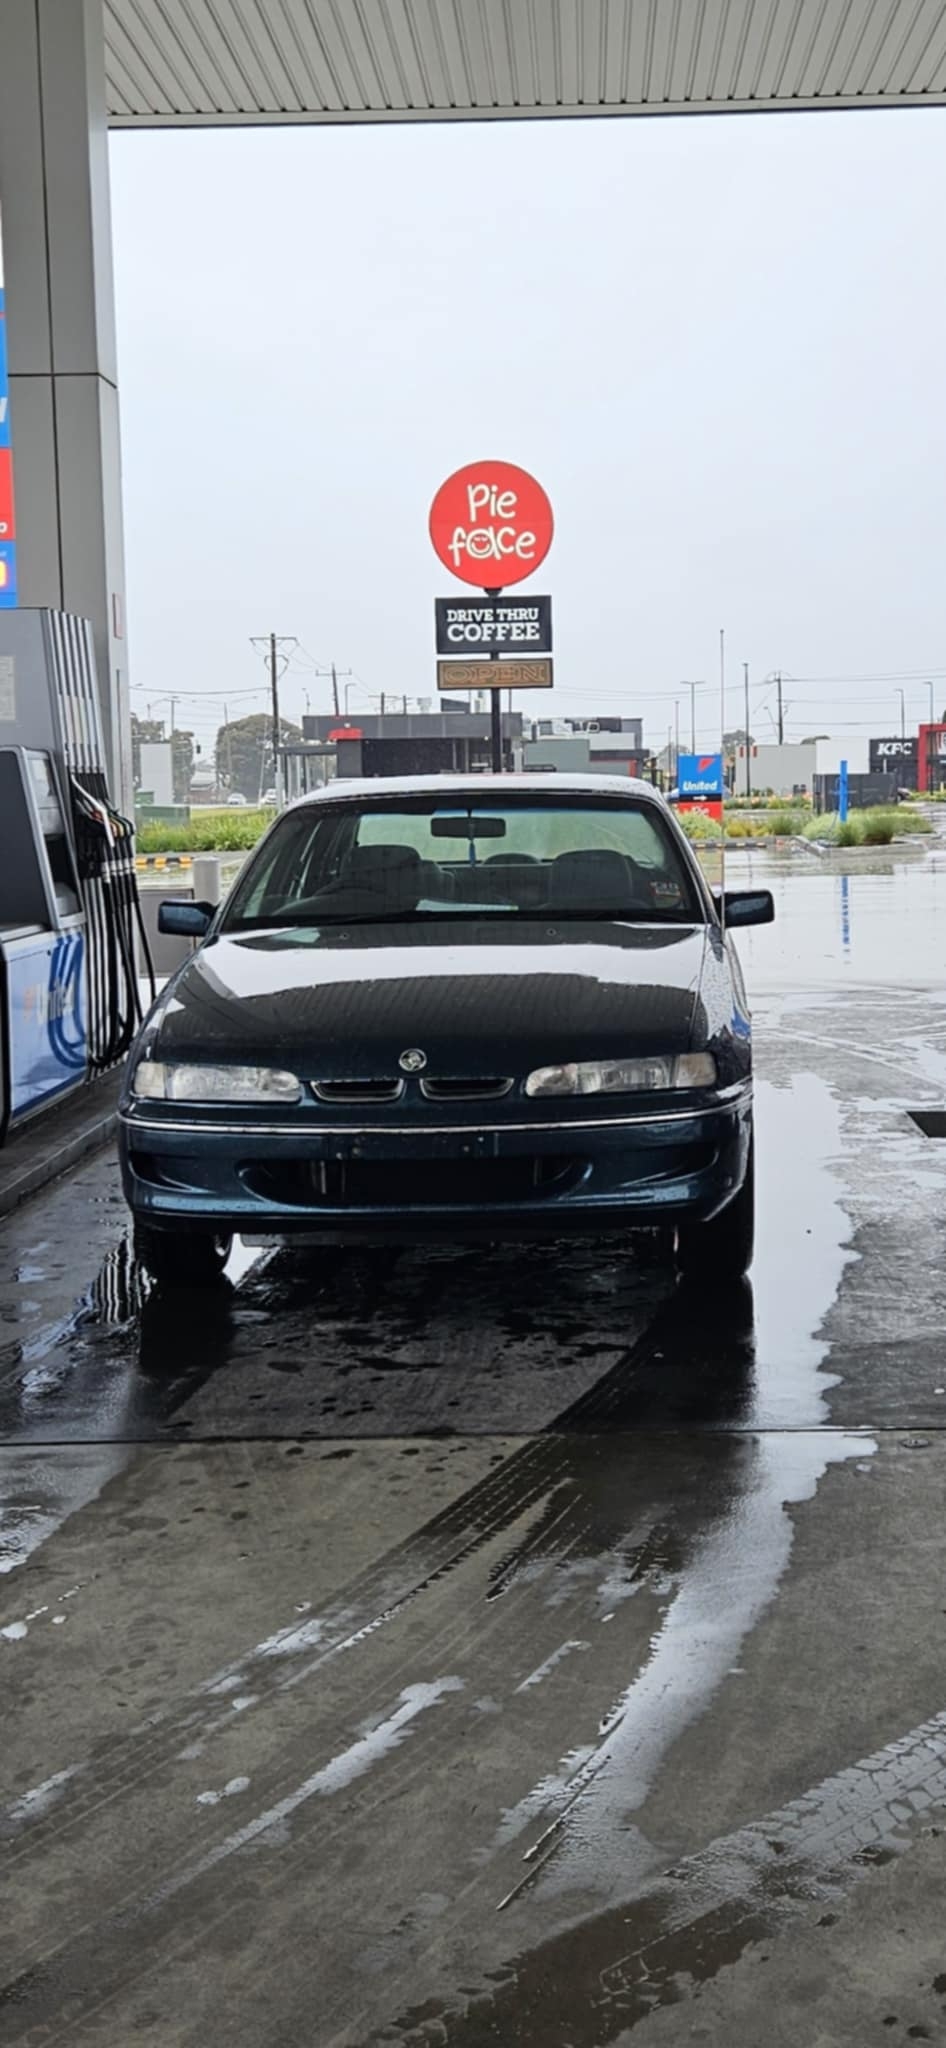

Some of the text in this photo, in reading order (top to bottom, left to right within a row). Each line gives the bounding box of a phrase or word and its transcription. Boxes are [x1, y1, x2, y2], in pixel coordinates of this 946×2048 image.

[448, 526, 537, 567] face
[447, 608, 539, 622] DRIVE THRU
[447, 623, 540, 642] COFFEE
[444, 663, 545, 685] OPEN
[877, 742, 913, 755] KFC
[683, 780, 718, 791] United
